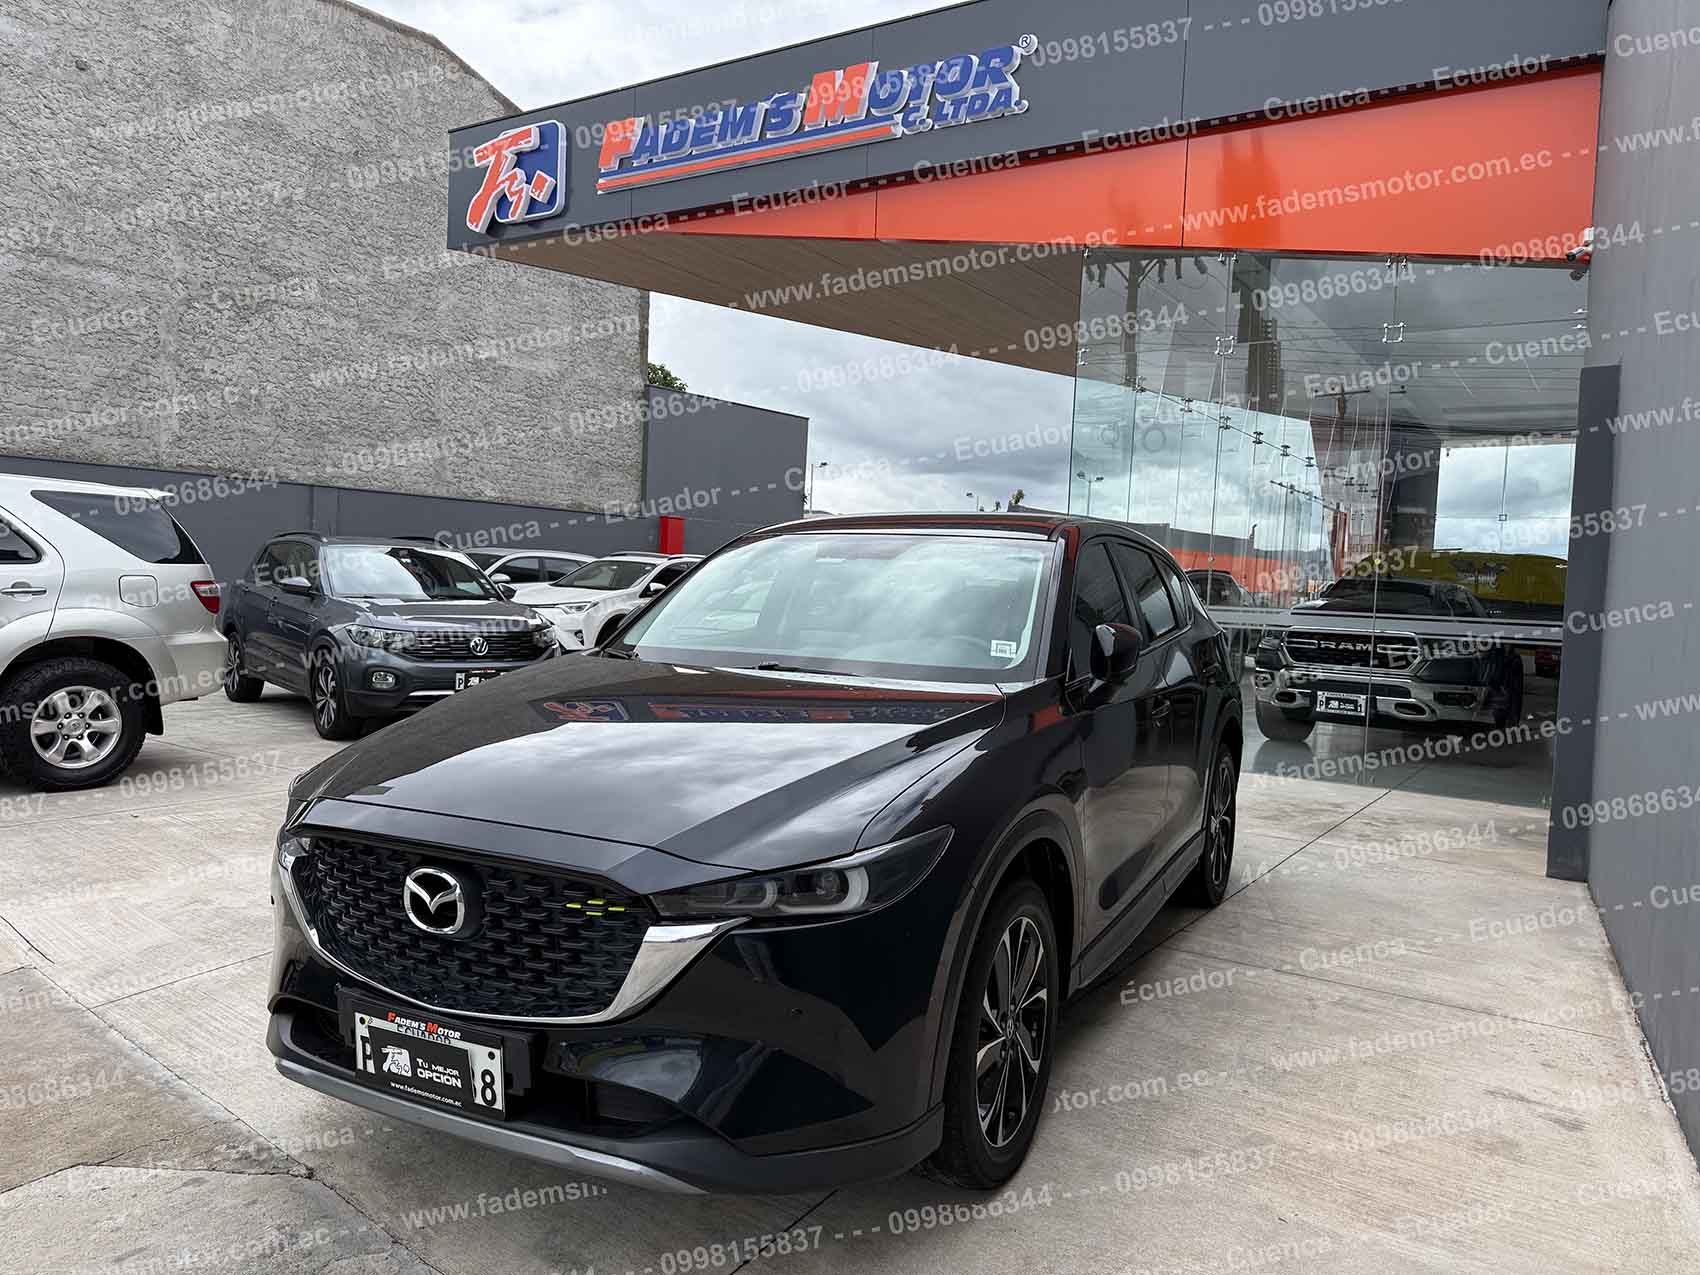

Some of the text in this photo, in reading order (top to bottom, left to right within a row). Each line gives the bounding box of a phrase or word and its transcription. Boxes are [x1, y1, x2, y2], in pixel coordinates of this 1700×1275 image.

[803, 45, 1020, 129] MOTOR
[934, 87, 1028, 128] LTDA.
[1319, 640, 1372, 652] RAM
[426, 1021, 462, 1040] MOTOR
[431, 1063, 460, 1077] MEJOR
